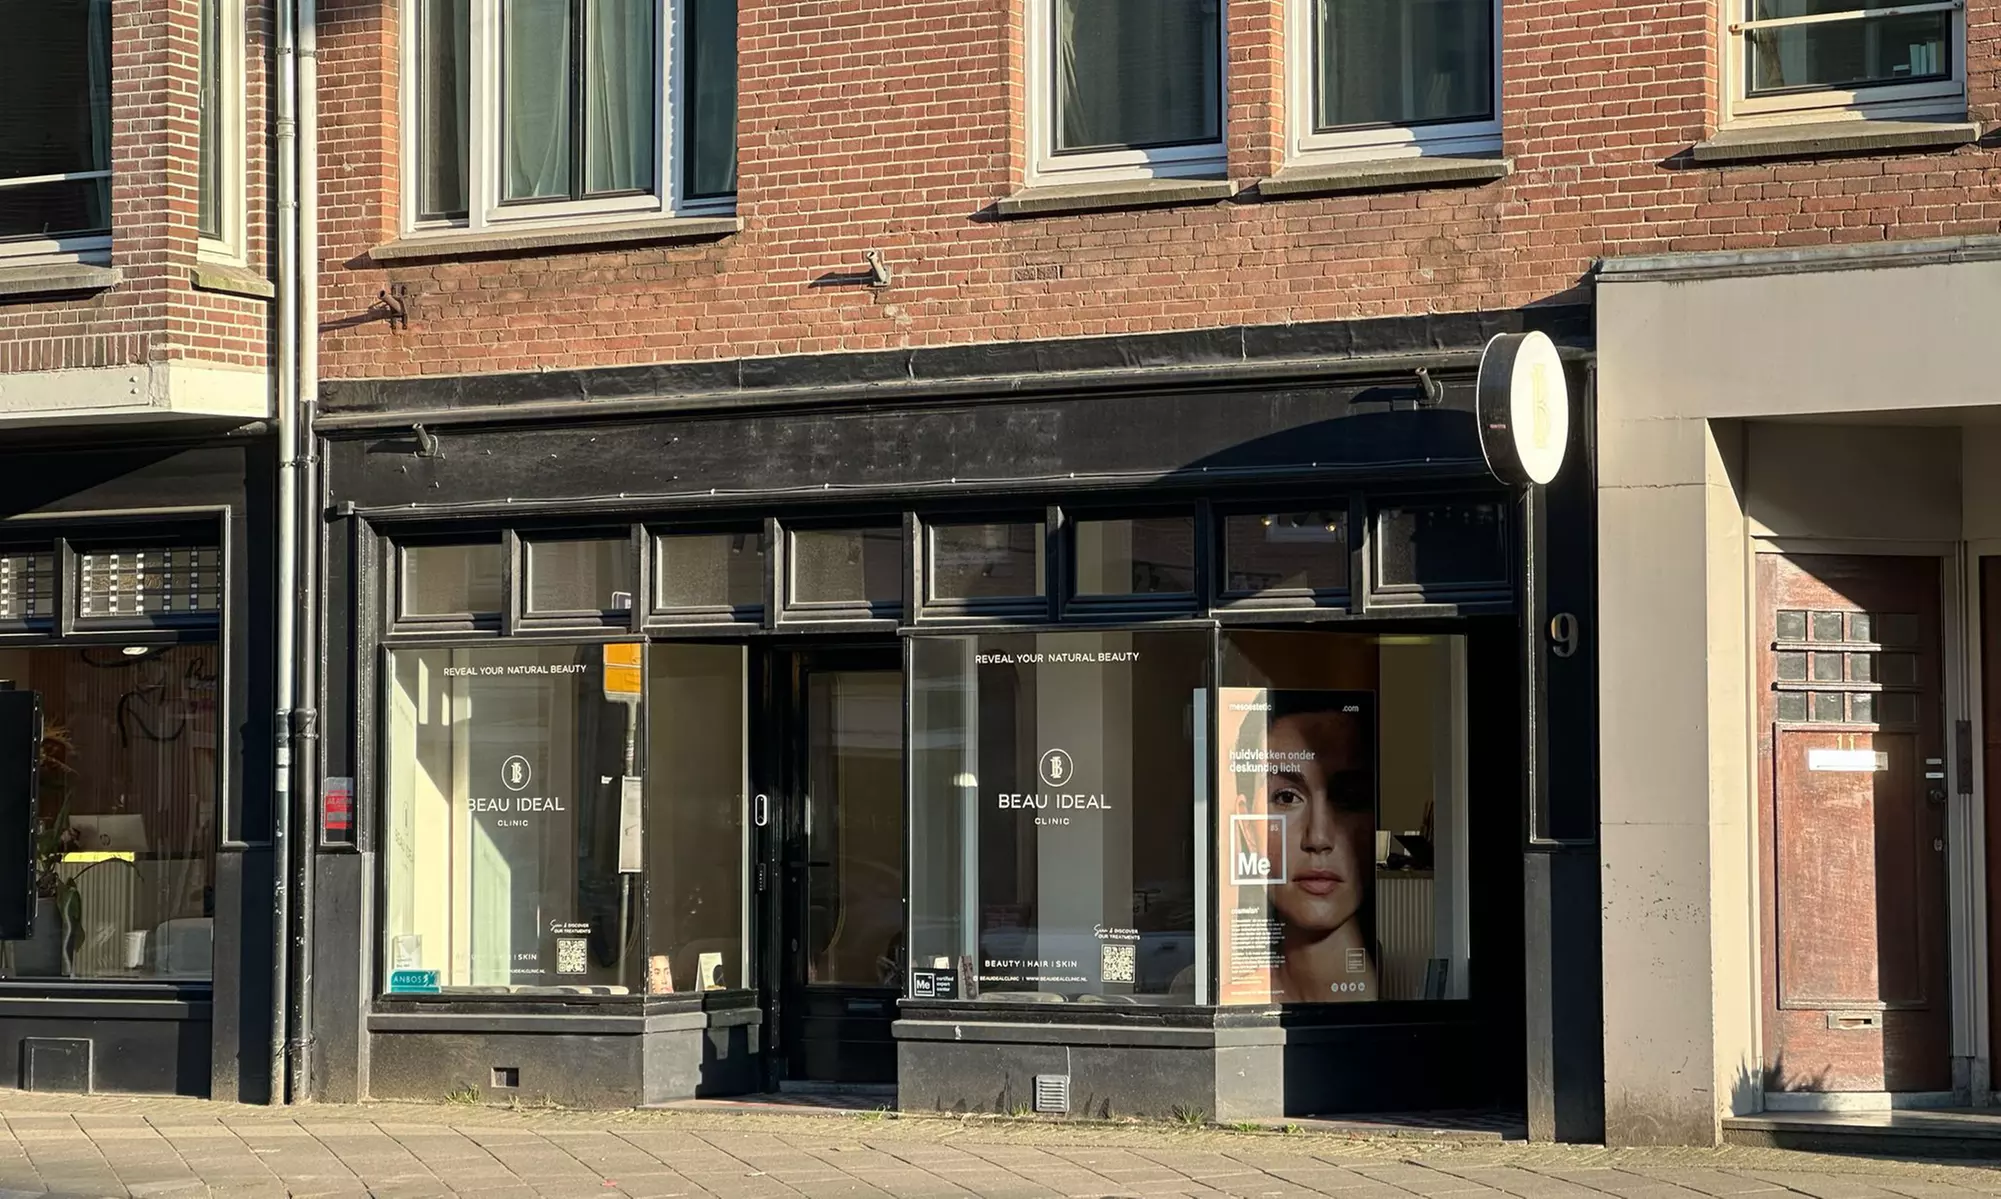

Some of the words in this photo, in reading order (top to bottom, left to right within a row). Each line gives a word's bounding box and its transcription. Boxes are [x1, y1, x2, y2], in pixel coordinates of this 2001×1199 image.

[1551, 613, 1578, 657] 9
[975, 654, 1014, 663] REVEAL
[1017, 653, 1044, 662] YOUR
[1048, 653, 1095, 662] NATURAL
[1098, 652, 1140, 661] BEAUTY
[443, 667, 478, 676] REVEAL
[480, 666, 504, 675] YOUR
[507, 665, 549, 674] NATURAL
[550, 664, 587, 673] BEAUTY
[1837, 734, 1855, 750] 11
[1229, 749, 1286, 760] huidvlekken
[1288, 750, 1316, 760] onder
[1229, 762, 1279, 774] deskundig
[1280, 763, 1301, 772] licht
[467, 798, 510, 811] BEAU
[517, 797, 565, 811] IDEAL
[998, 794, 1048, 808] BEAU
[1056, 794, 1112, 808] IDEAL
[1238, 852, 1271, 876] Me
[916, 980, 930, 989] Me
